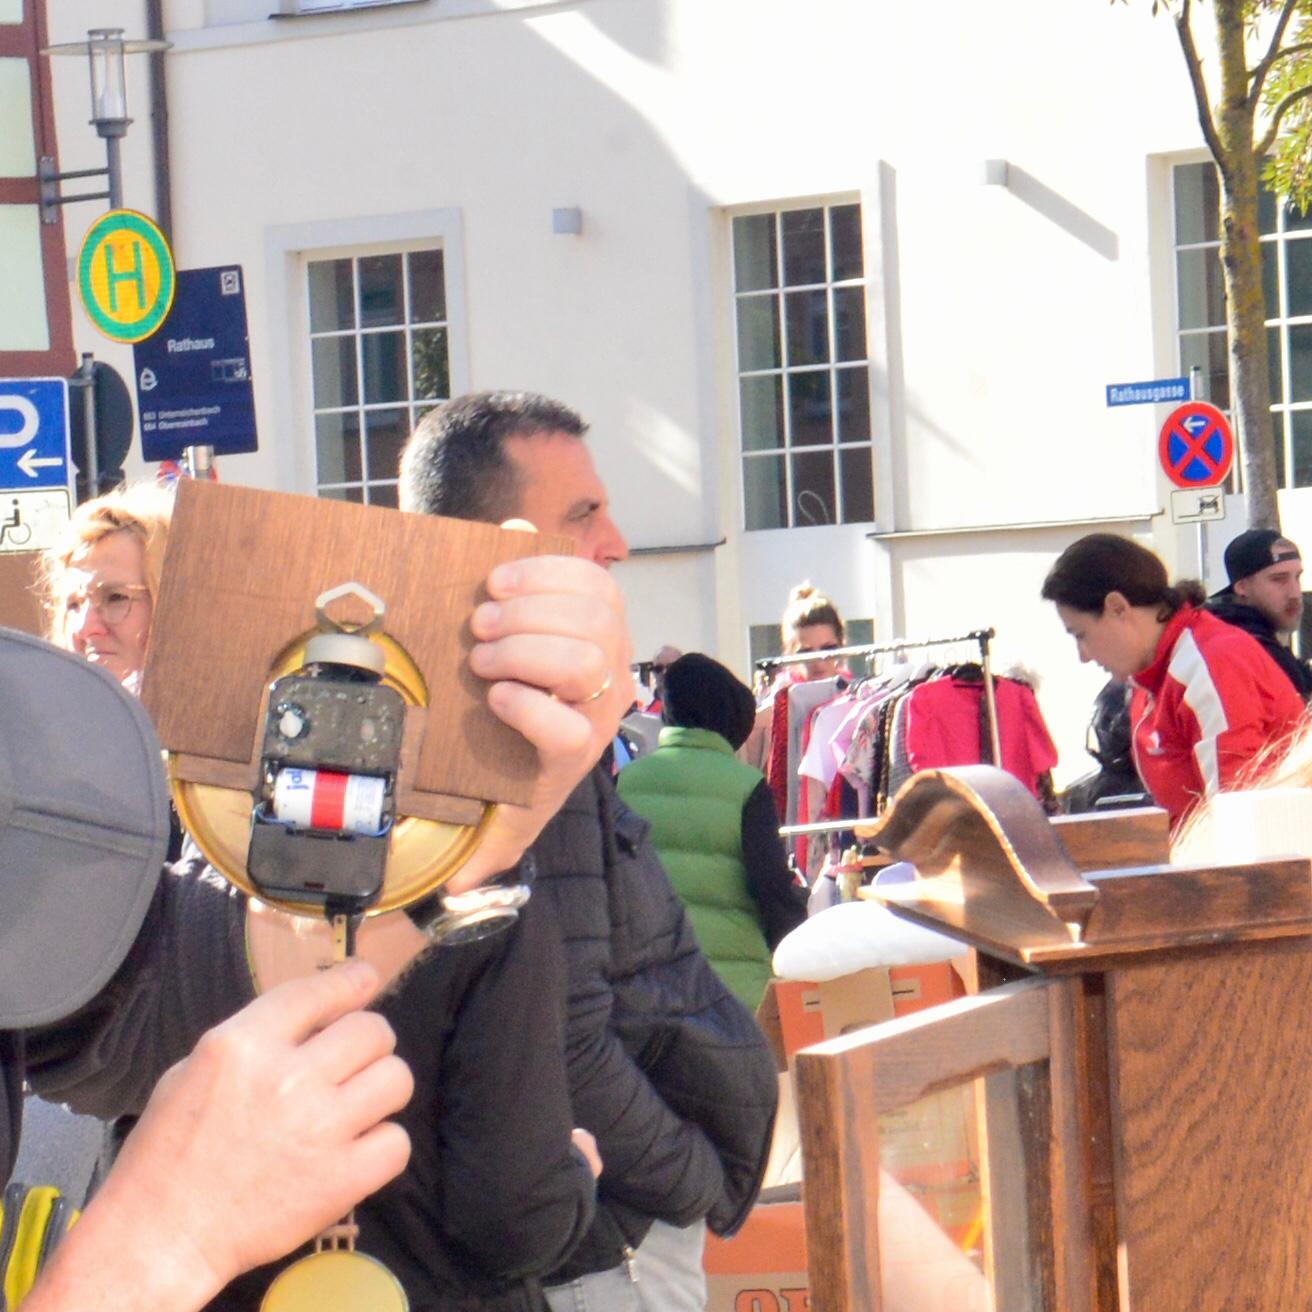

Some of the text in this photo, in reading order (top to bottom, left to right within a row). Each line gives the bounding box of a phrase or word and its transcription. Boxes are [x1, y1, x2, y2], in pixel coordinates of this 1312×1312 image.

[104, 240, 147, 313] H
[168, 338, 215, 353] Rathaus
[1109, 384, 1185, 402] Rathausgasse
